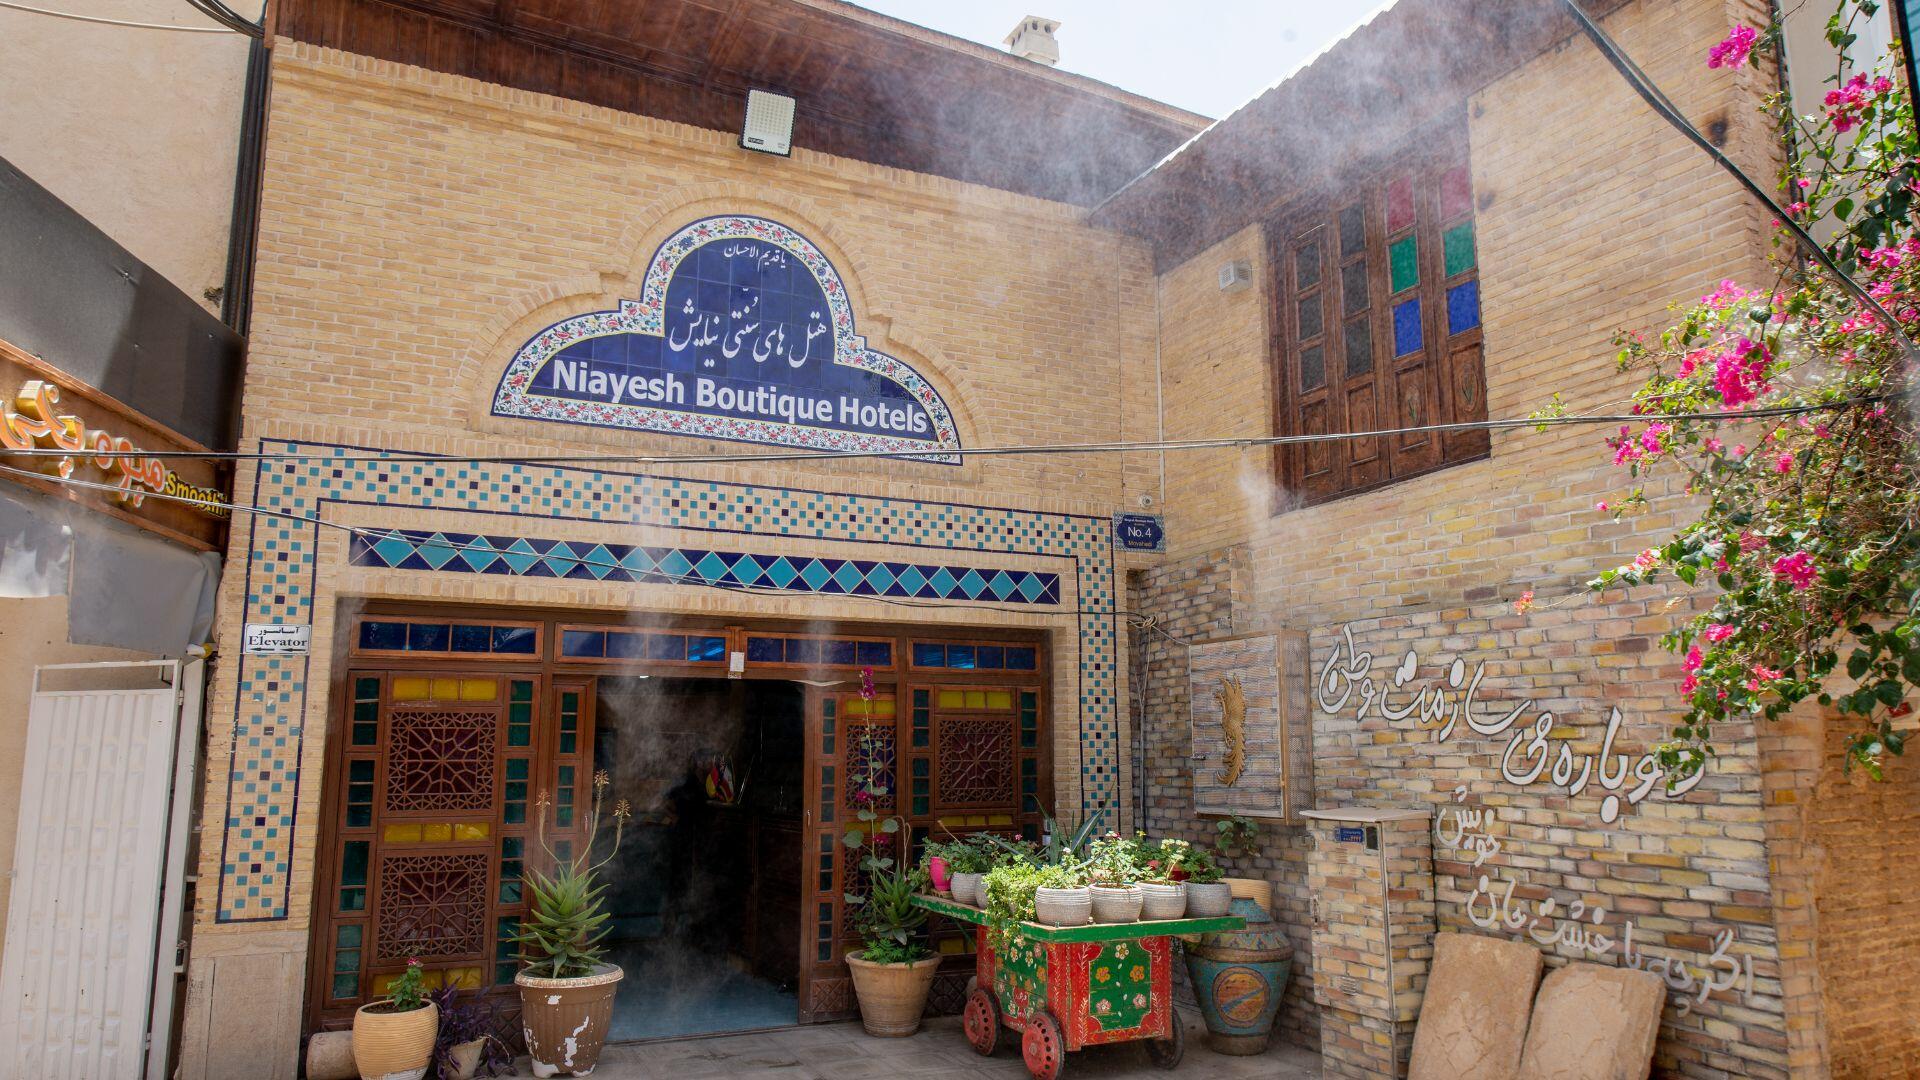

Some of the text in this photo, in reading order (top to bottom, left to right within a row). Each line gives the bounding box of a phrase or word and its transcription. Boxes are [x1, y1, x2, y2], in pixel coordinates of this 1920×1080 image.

[669, 298, 720, 368] نیایش
[752, 322, 785, 363] های
[788, 311, 827, 369] هتل
[553, 359, 928, 434] Niayesh Boutique Hotels
[1127, 526, 1152, 538] No. 4
[248, 635, 308, 646] Elevator
[258, 626, 300, 635] آسانسور
[1318, 623, 1376, 722] وطن
